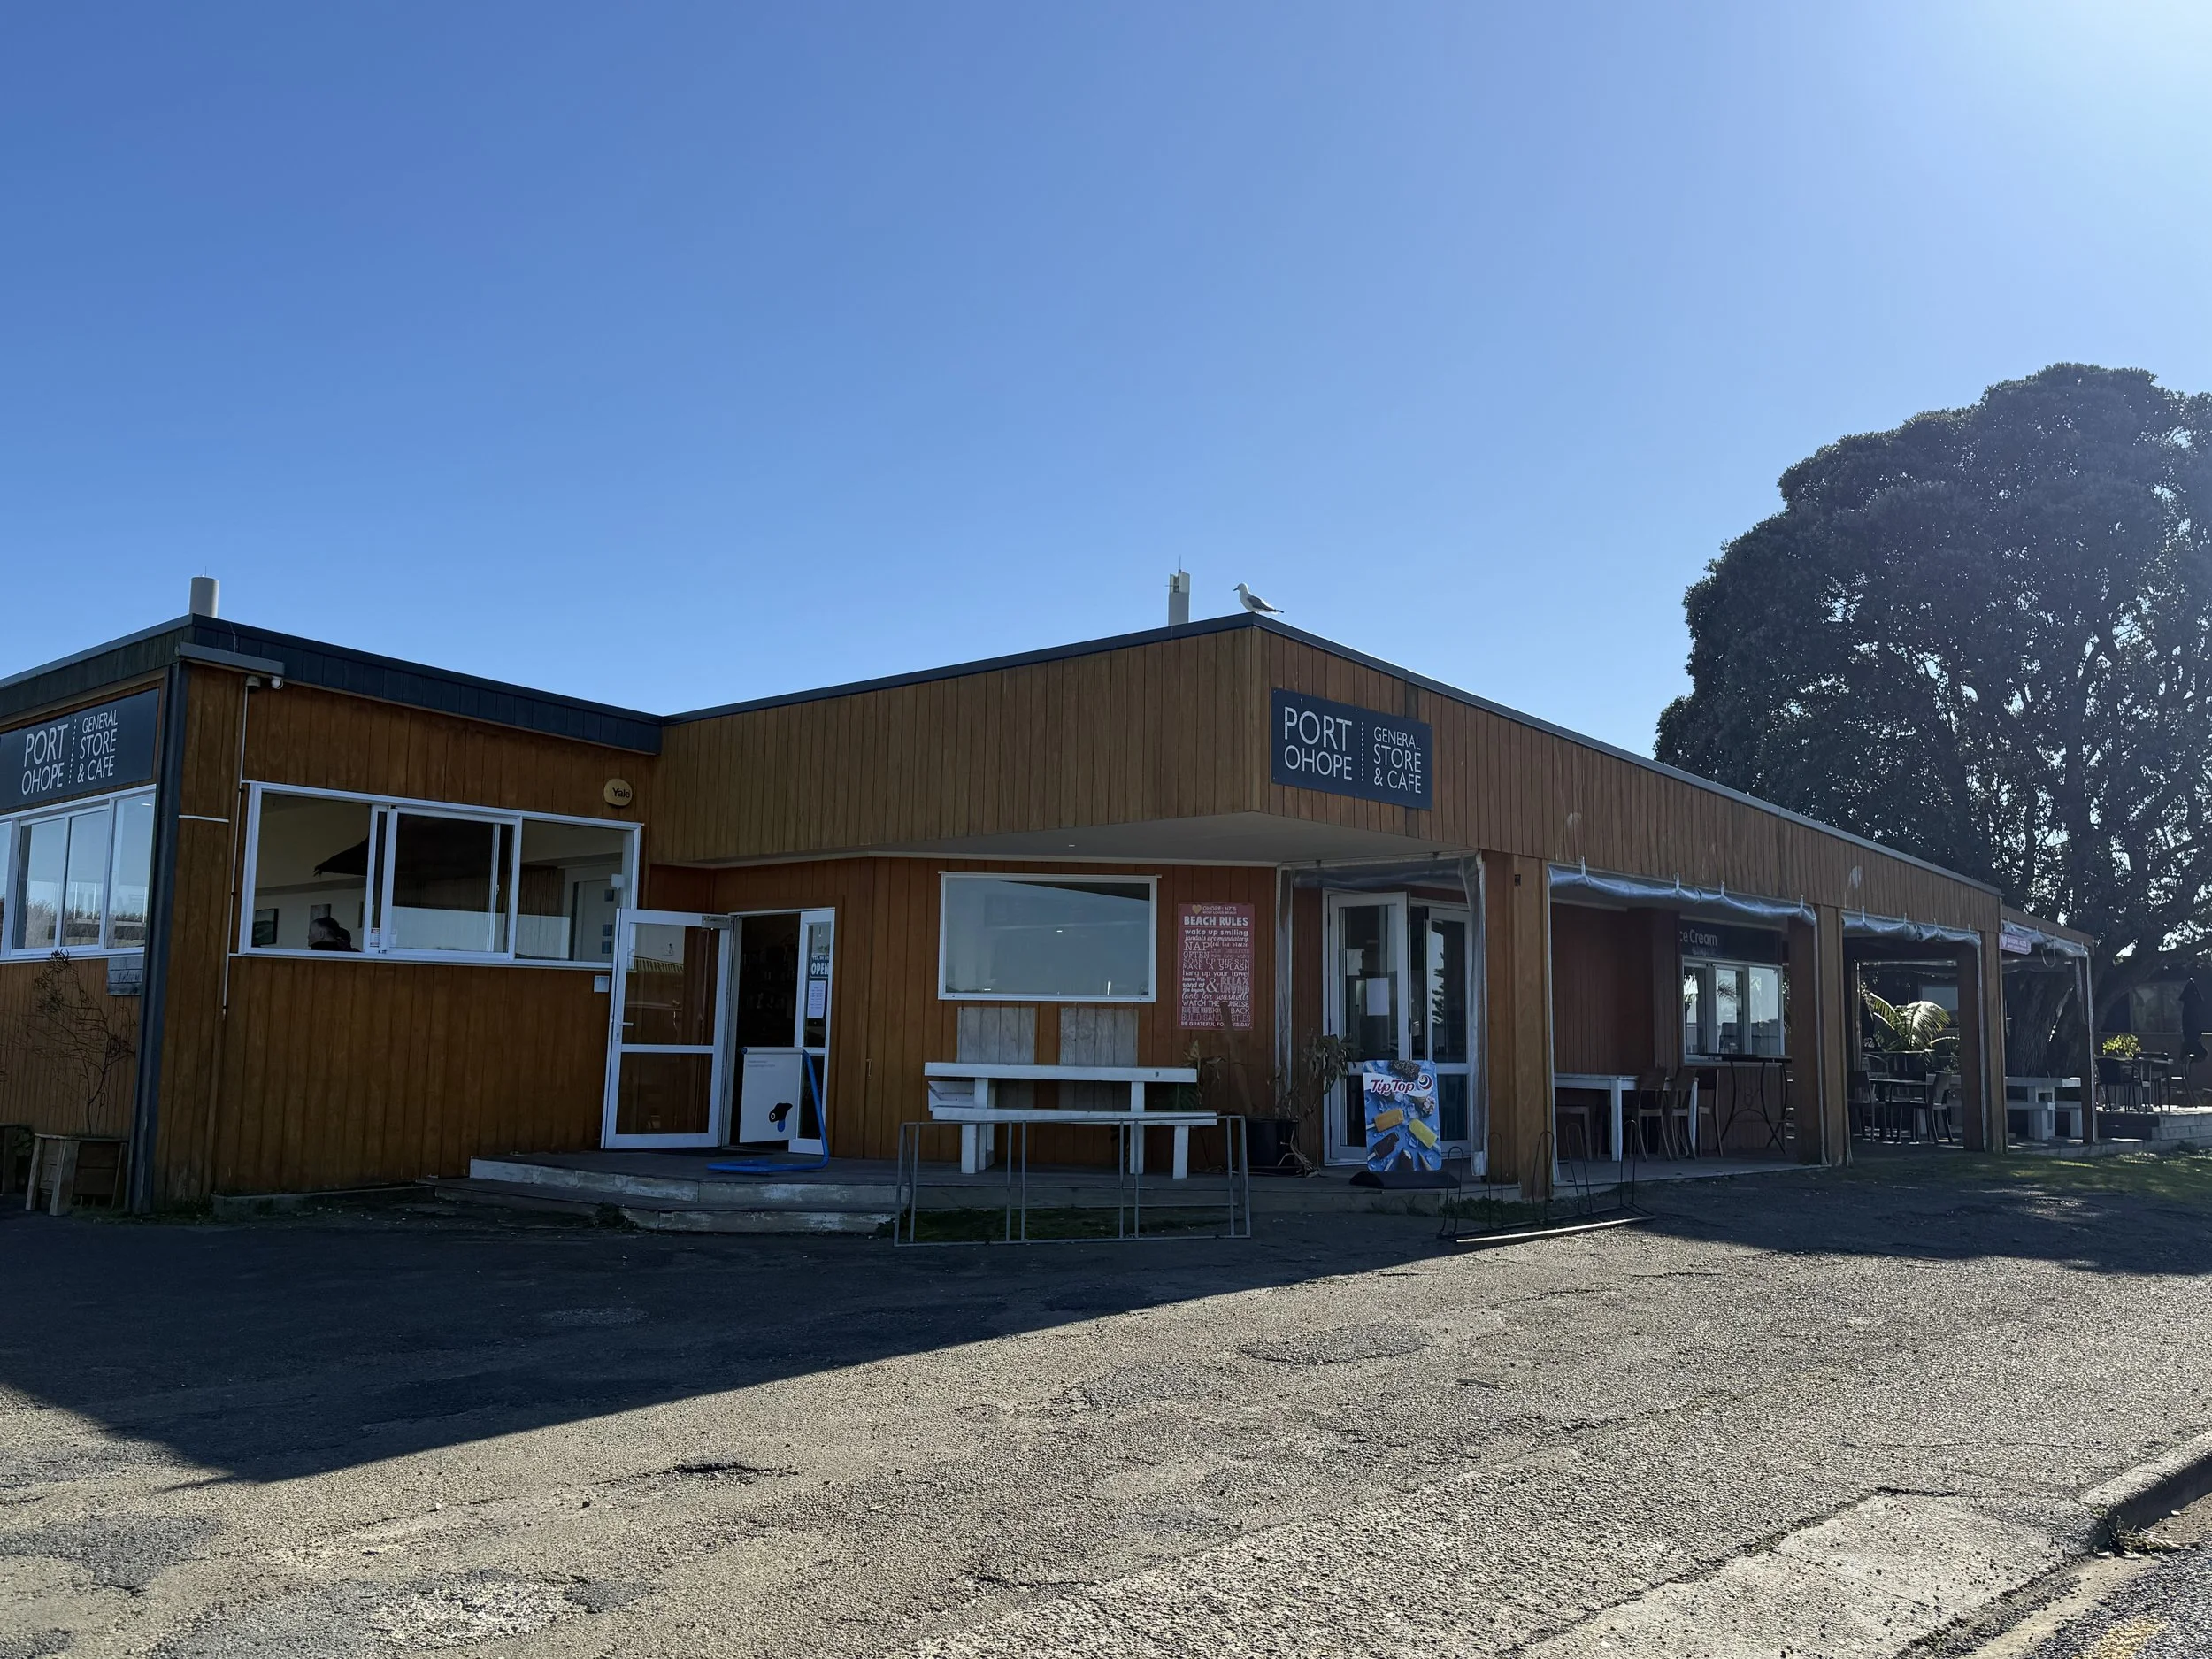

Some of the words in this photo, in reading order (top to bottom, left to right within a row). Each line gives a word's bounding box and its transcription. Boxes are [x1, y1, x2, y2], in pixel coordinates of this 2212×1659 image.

[81, 710, 119, 734] GENERAL
[1284, 706, 1353, 752] PORT
[24, 723, 69, 768] PORT
[79, 728, 118, 760] STORE
[1373, 726, 1422, 751] GENERAL
[1284, 744, 1353, 781] OHOPE
[1373, 743, 1422, 774] STORE
[77, 763, 86, 784] &
[87, 755, 116, 781] CAFE
[21, 762, 65, 795] OHOPE
[1373, 767, 1384, 787] &
[1386, 769, 1422, 795] CAFE
[612, 787, 632, 799] Yale
[1184, 916, 1216, 926] BEACH
[1219, 917, 1248, 926] RULES
[1183, 941, 1210, 951] NAP
[1689, 929, 1718, 946] Cream
[810, 962, 829, 975] OPEN
[1206, 977, 1220, 993] &
[1220, 976, 1249, 985] RELAX
[1220, 984, 1250, 994] UNWIND
[1201, 992, 1213, 1002] for
[1181, 1013, 1202, 1022] BUILD
[1370, 1079, 1392, 1094] Tip
[1391, 1079, 1416, 1094] Top
